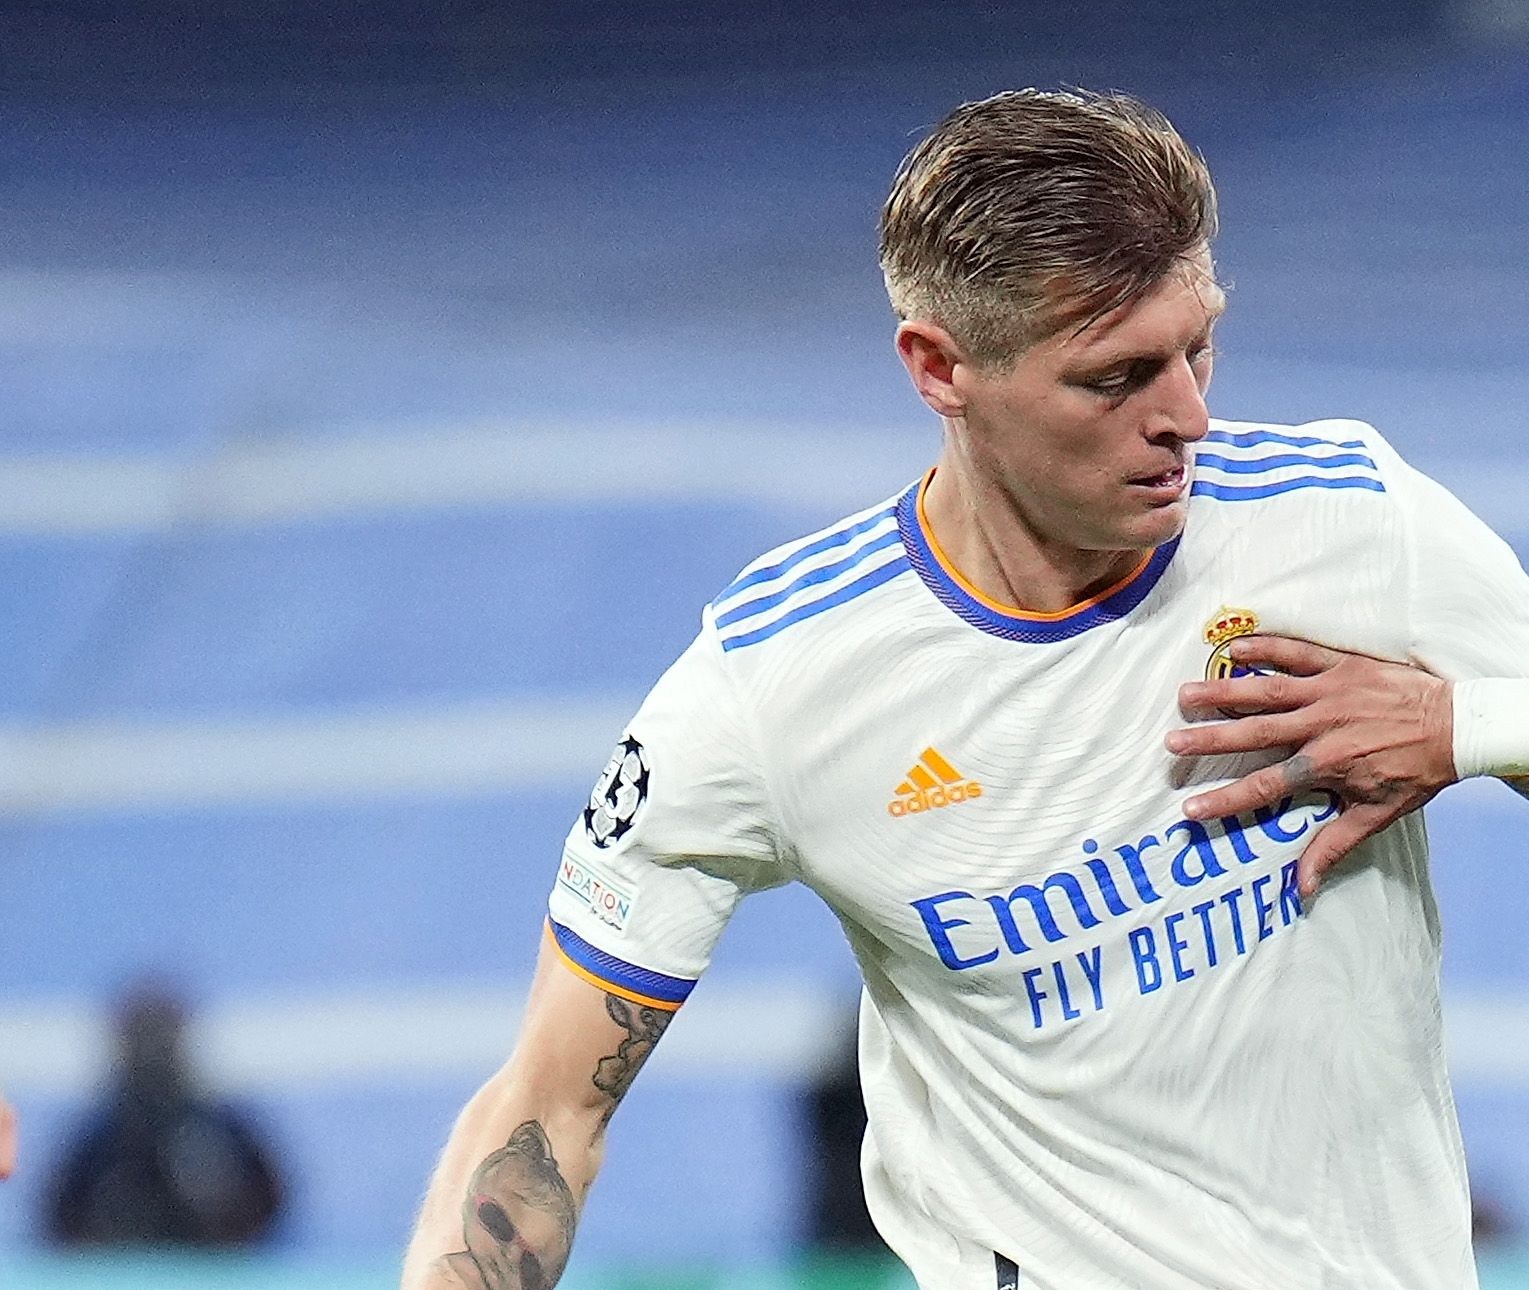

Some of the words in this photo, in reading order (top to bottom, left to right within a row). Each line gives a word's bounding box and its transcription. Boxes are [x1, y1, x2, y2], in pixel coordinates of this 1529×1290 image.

[886, 781, 983, 818] adidas
[562, 860, 630, 920] NDATION
[1021, 945, 1105, 1029] FLY
[1128, 859, 1305, 995] BETTER
